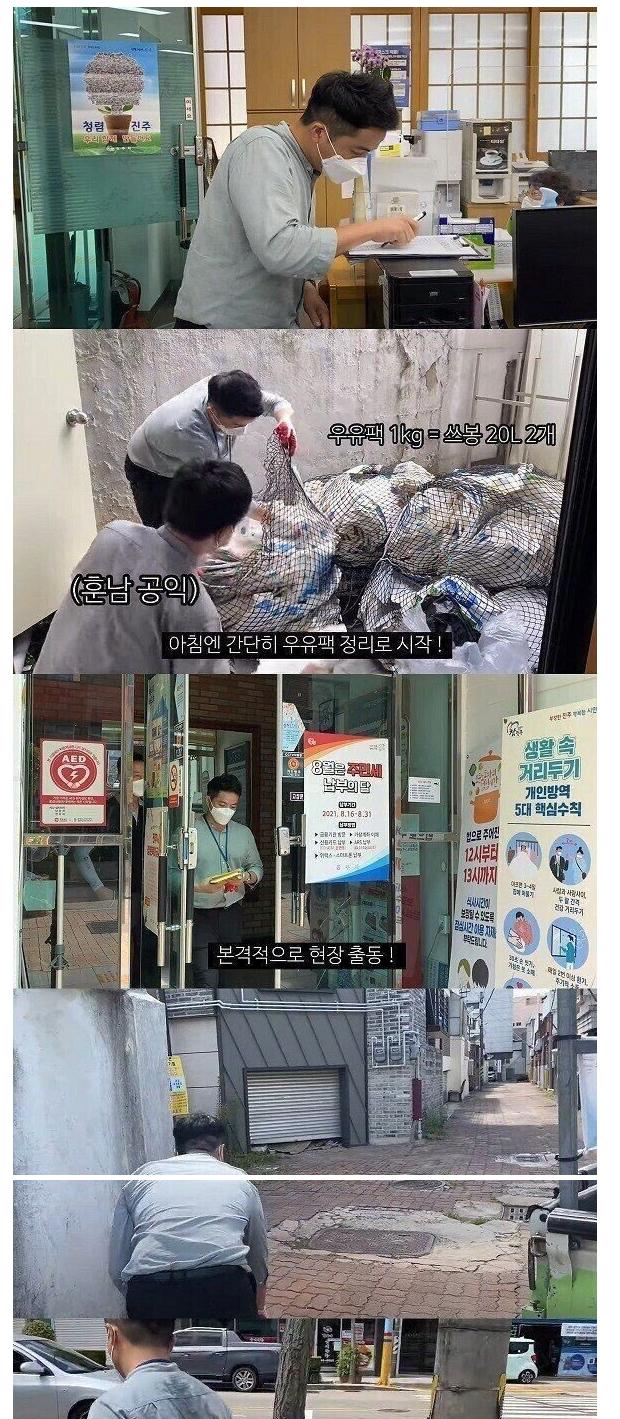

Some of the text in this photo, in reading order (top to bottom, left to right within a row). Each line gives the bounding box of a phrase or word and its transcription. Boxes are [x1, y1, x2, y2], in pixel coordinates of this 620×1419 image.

[83, 121, 151, 132] 청렴 진주
[524, 735, 575, 759] 생활 속
[62, 755, 86, 763] AED
[312, 760, 383, 778] 8월은 주민세
[519, 757, 581, 782] 거리두기
[323, 779, 371, 793] 납부의 달
[526, 785, 570, 799] 개인방역
[515, 802, 582, 816] 5대 핵심수칙
[465, 843, 498, 862] 12시부터
[464, 866, 497, 885] 13시까지
